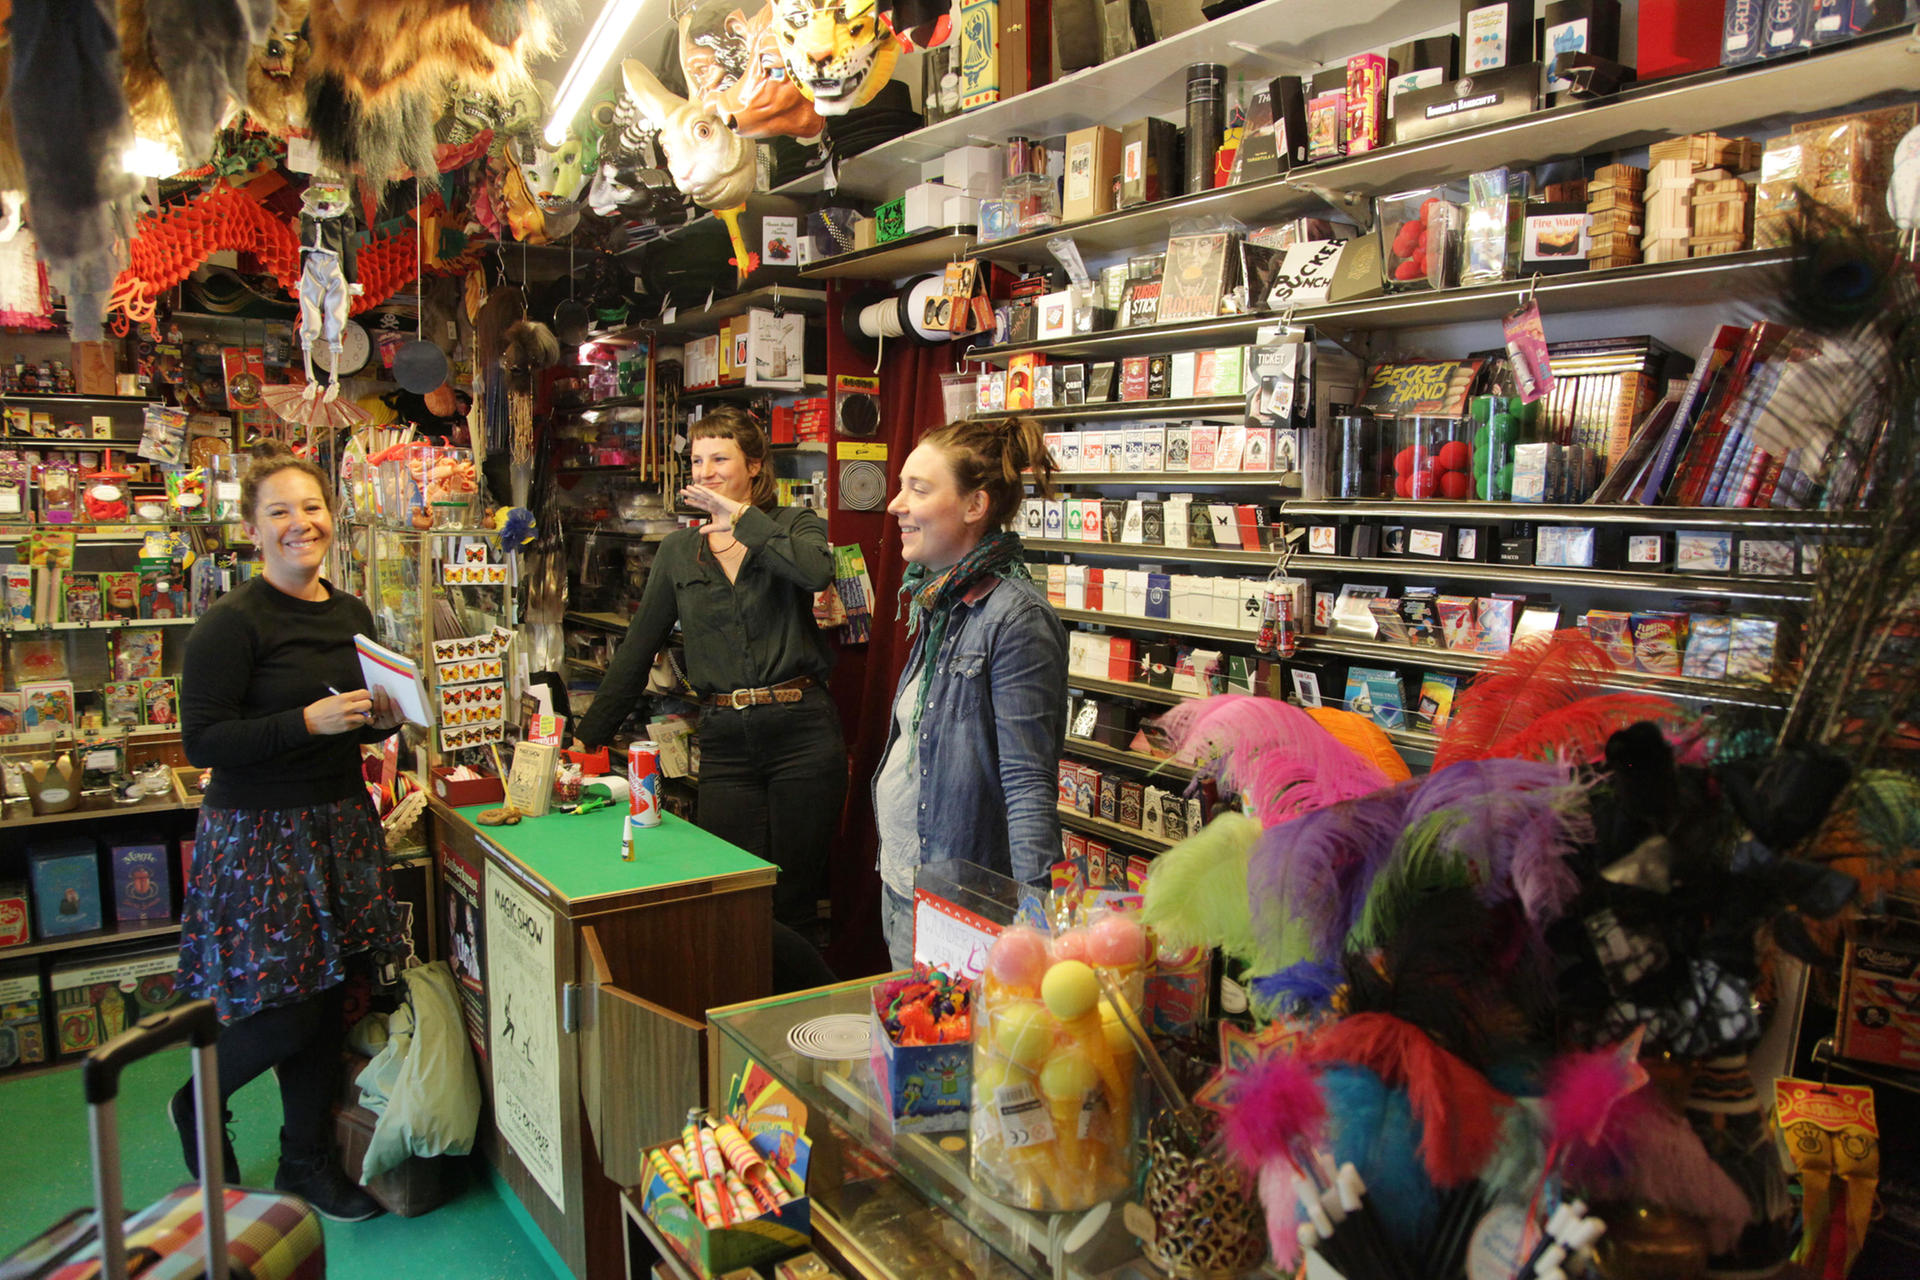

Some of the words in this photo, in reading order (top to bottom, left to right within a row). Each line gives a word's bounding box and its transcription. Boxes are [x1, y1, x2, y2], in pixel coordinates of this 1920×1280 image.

[1533, 218, 1552, 229] Fire
[1555, 216, 1586, 228] Wallet
[1133, 283, 1163, 300] TURBO
[1131, 298, 1159, 315] STICK
[1162, 294, 1214, 315] FLOATING
[1257, 352, 1286, 367] TICKET
[1369, 360, 1461, 389] SECRET
[1065, 381, 1083, 390] ORBIT
[1388, 382, 1448, 403] HAND
[1062, 446, 1079, 457] Bee
[1083, 446, 1103, 457] Bee
[1105, 444, 1122, 456] Bee
[1125, 441, 1143, 453] Bee
[1144, 443, 1162, 455] Bee
[494, 887, 518, 923] MAGIC
[517, 907, 545, 946] SHOW
